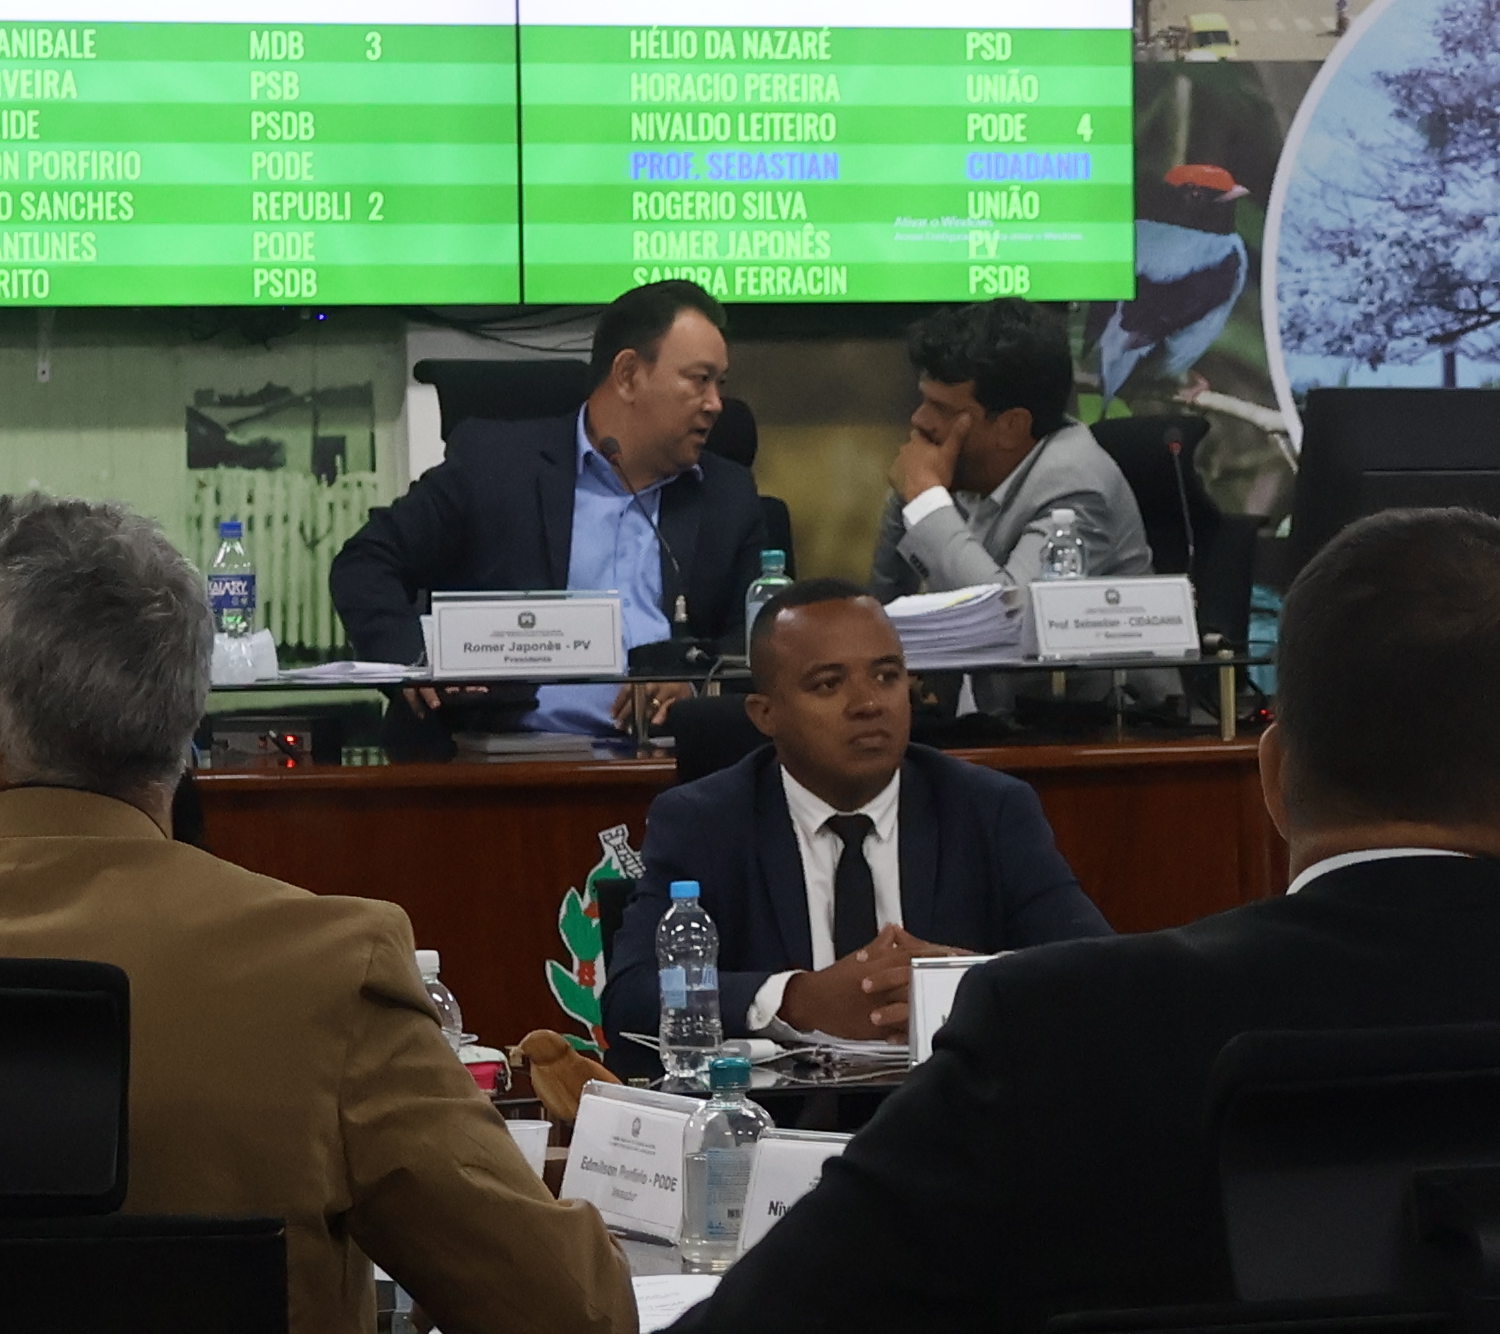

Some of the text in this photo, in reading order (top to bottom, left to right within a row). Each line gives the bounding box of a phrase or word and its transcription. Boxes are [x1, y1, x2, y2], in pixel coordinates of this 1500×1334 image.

[250, 31, 304, 61] MDB
[364, 32, 382, 61] 3
[630, 25, 832, 60] HÉLIO DA NAZARÉ
[966, 32, 1012, 61] PSD
[250, 71, 300, 100] PSB
[630, 73, 840, 103] HORACIO PEREIRA
[966, 69, 1038, 103] UNIÃO
[251, 111, 315, 141] PSDB
[631, 113, 837, 142] NIVALDO LEITEIRO
[966, 114, 1027, 142] PODE
[1077, 114, 1093, 142] 4
[31, 150, 142, 181] PORFIRIO
[251, 151, 314, 182] PODE
[630, 152, 840, 182] PROF. SEBASTIAN
[20, 191, 134, 222] SANCHES
[252, 192, 351, 222] REPUBLI
[368, 192, 384, 222] 2
[633, 191, 808, 221] ROGERIO SILVA
[968, 186, 1040, 220] UNIÃO
[252, 231, 316, 262] PODE
[633, 223, 832, 260] ROMER JAPONÊS
[968, 231, 1000, 260] PV
[253, 267, 317, 298] PSDB
[735, 266, 847, 295] FERRACIN
[969, 266, 1031, 294] PSDB
[464, 642, 504, 653] Romer
[509, 641, 561, 653] Japonês
[574, 640, 591, 650] PV
[654, 1172, 677, 1192] PODE
